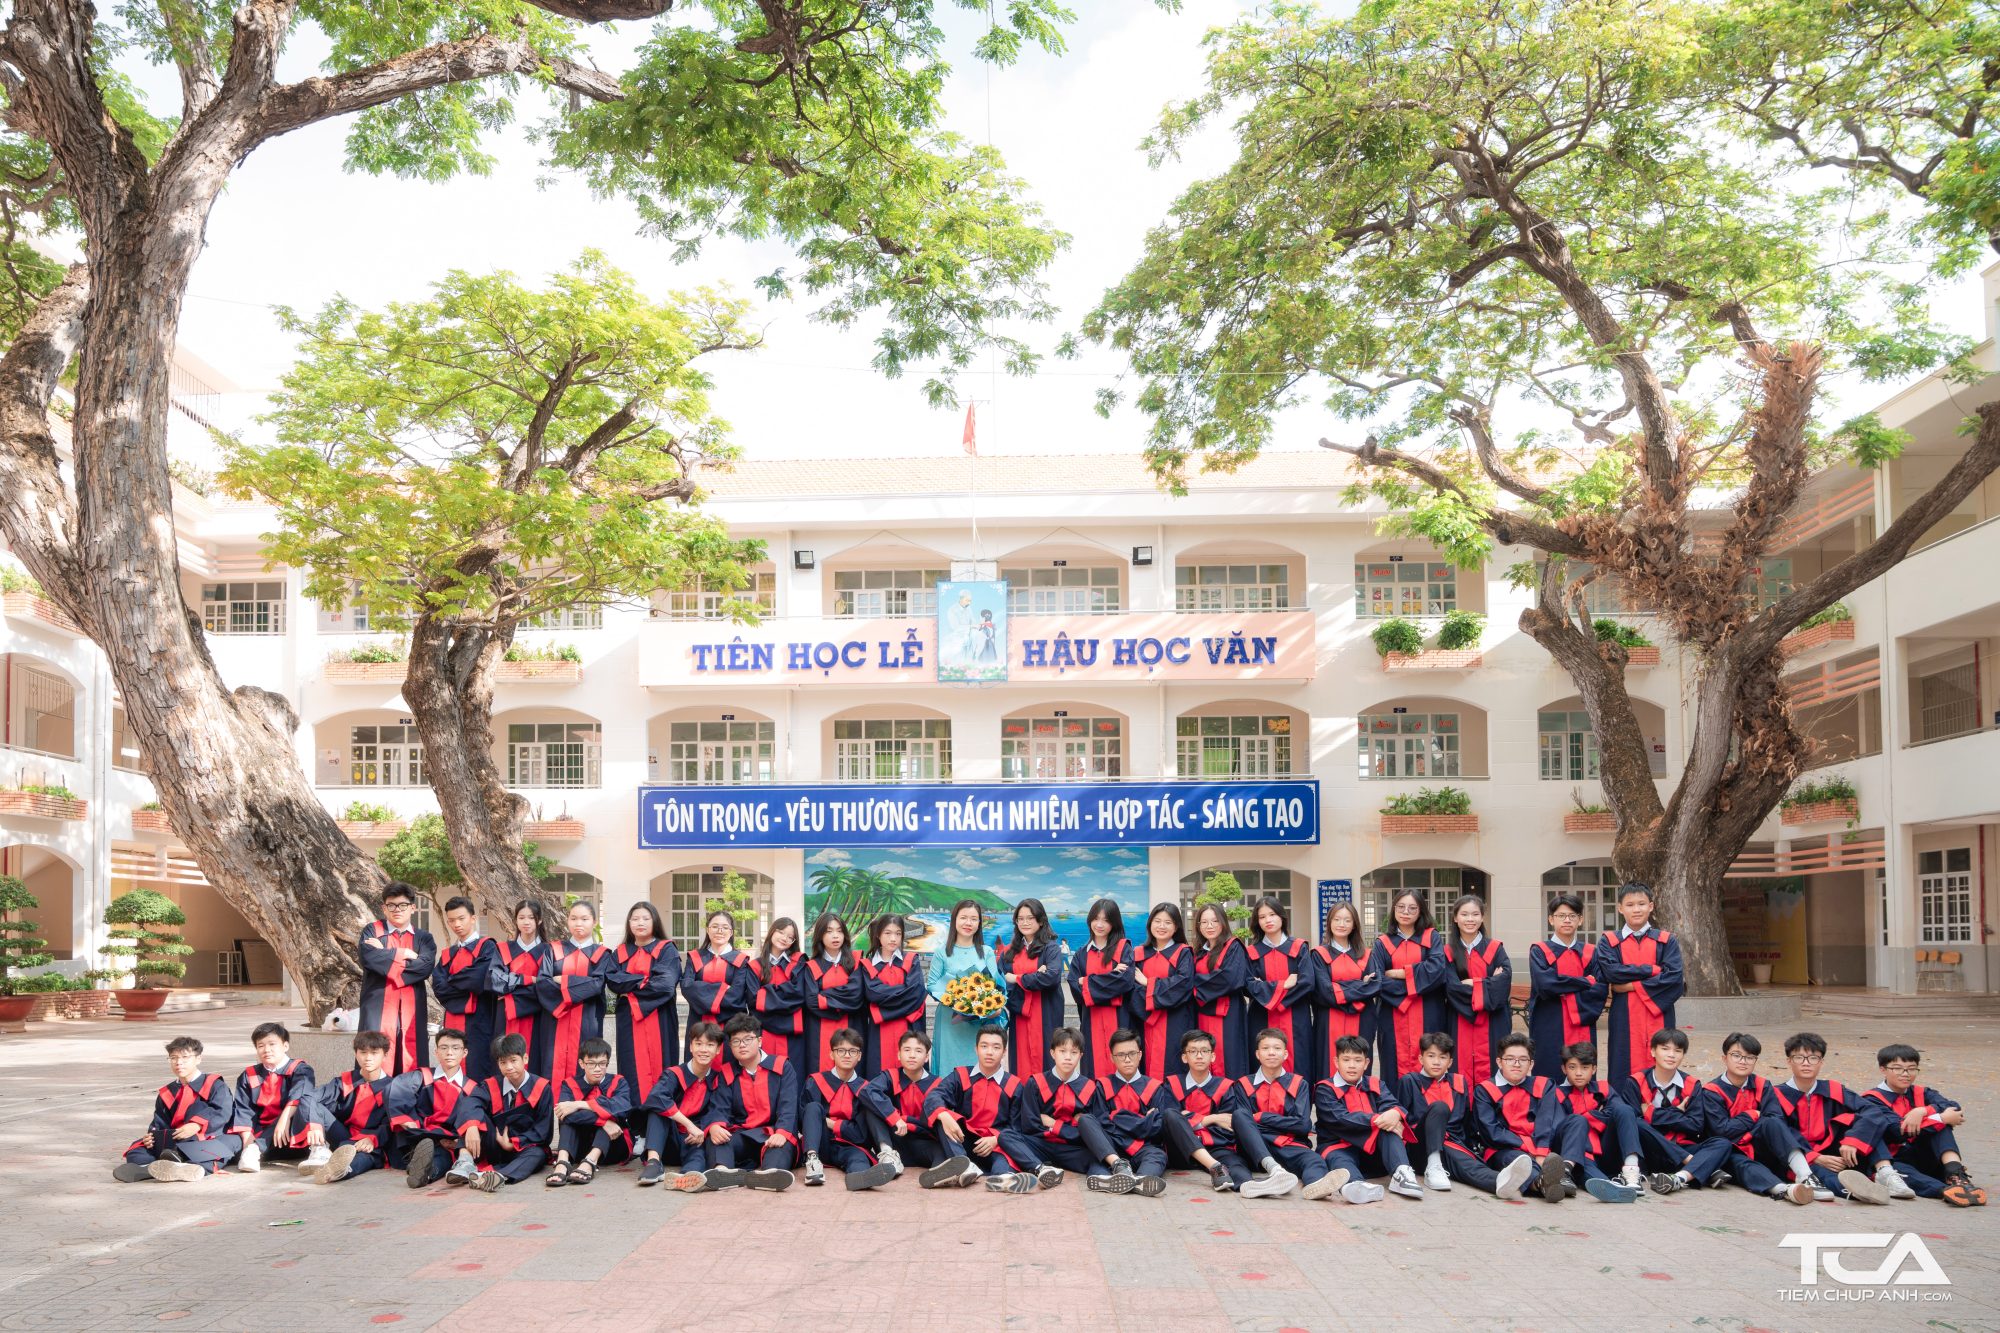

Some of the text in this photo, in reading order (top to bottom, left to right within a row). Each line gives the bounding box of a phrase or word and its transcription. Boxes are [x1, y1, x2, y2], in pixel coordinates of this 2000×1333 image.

[788, 641, 867, 676] HỌC
[879, 628, 923, 668] LỄ
[1022, 630, 1277, 672] HẬU HỌC VĂN
[654, 797, 694, 832] TÔN
[699, 803, 769, 840] TRỌNG
[785, 796, 825, 832] YÊU
[829, 798, 918, 831] THƯƠNG
[935, 795, 1003, 831] TRÁCH
[1009, 794, 1080, 839] NHIỆM
[1099, 798, 1143, 838] HỢP
[1147, 793, 1185, 829] TÁC
[1202, 793, 1259, 829] SÁNG
[1263, 798, 1303, 837] TẠO
